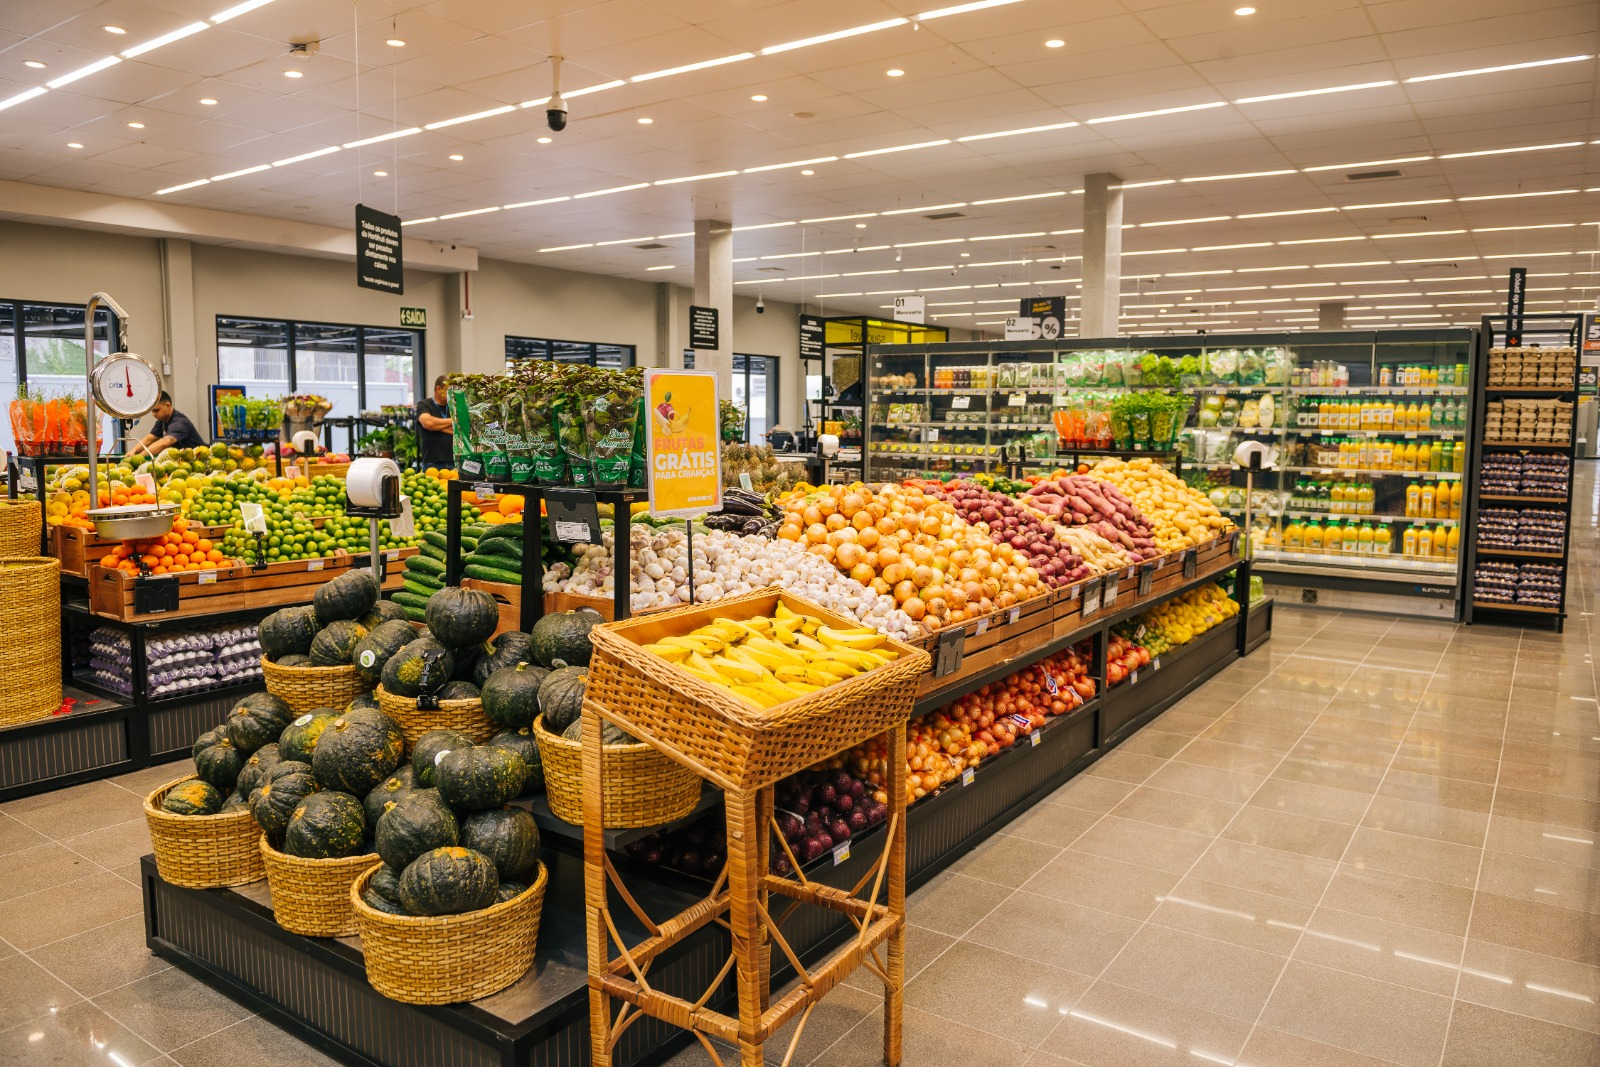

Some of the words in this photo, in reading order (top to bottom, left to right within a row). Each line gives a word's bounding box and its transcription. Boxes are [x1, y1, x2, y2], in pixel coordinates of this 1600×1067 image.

[896, 298, 905, 307] 01
[406, 308, 425, 324] SAÍDA
[654, 438, 705, 451] FRUTAS
[655, 448, 714, 470] GRÁTIS
[678, 469, 715, 479] CRIANÇAS
